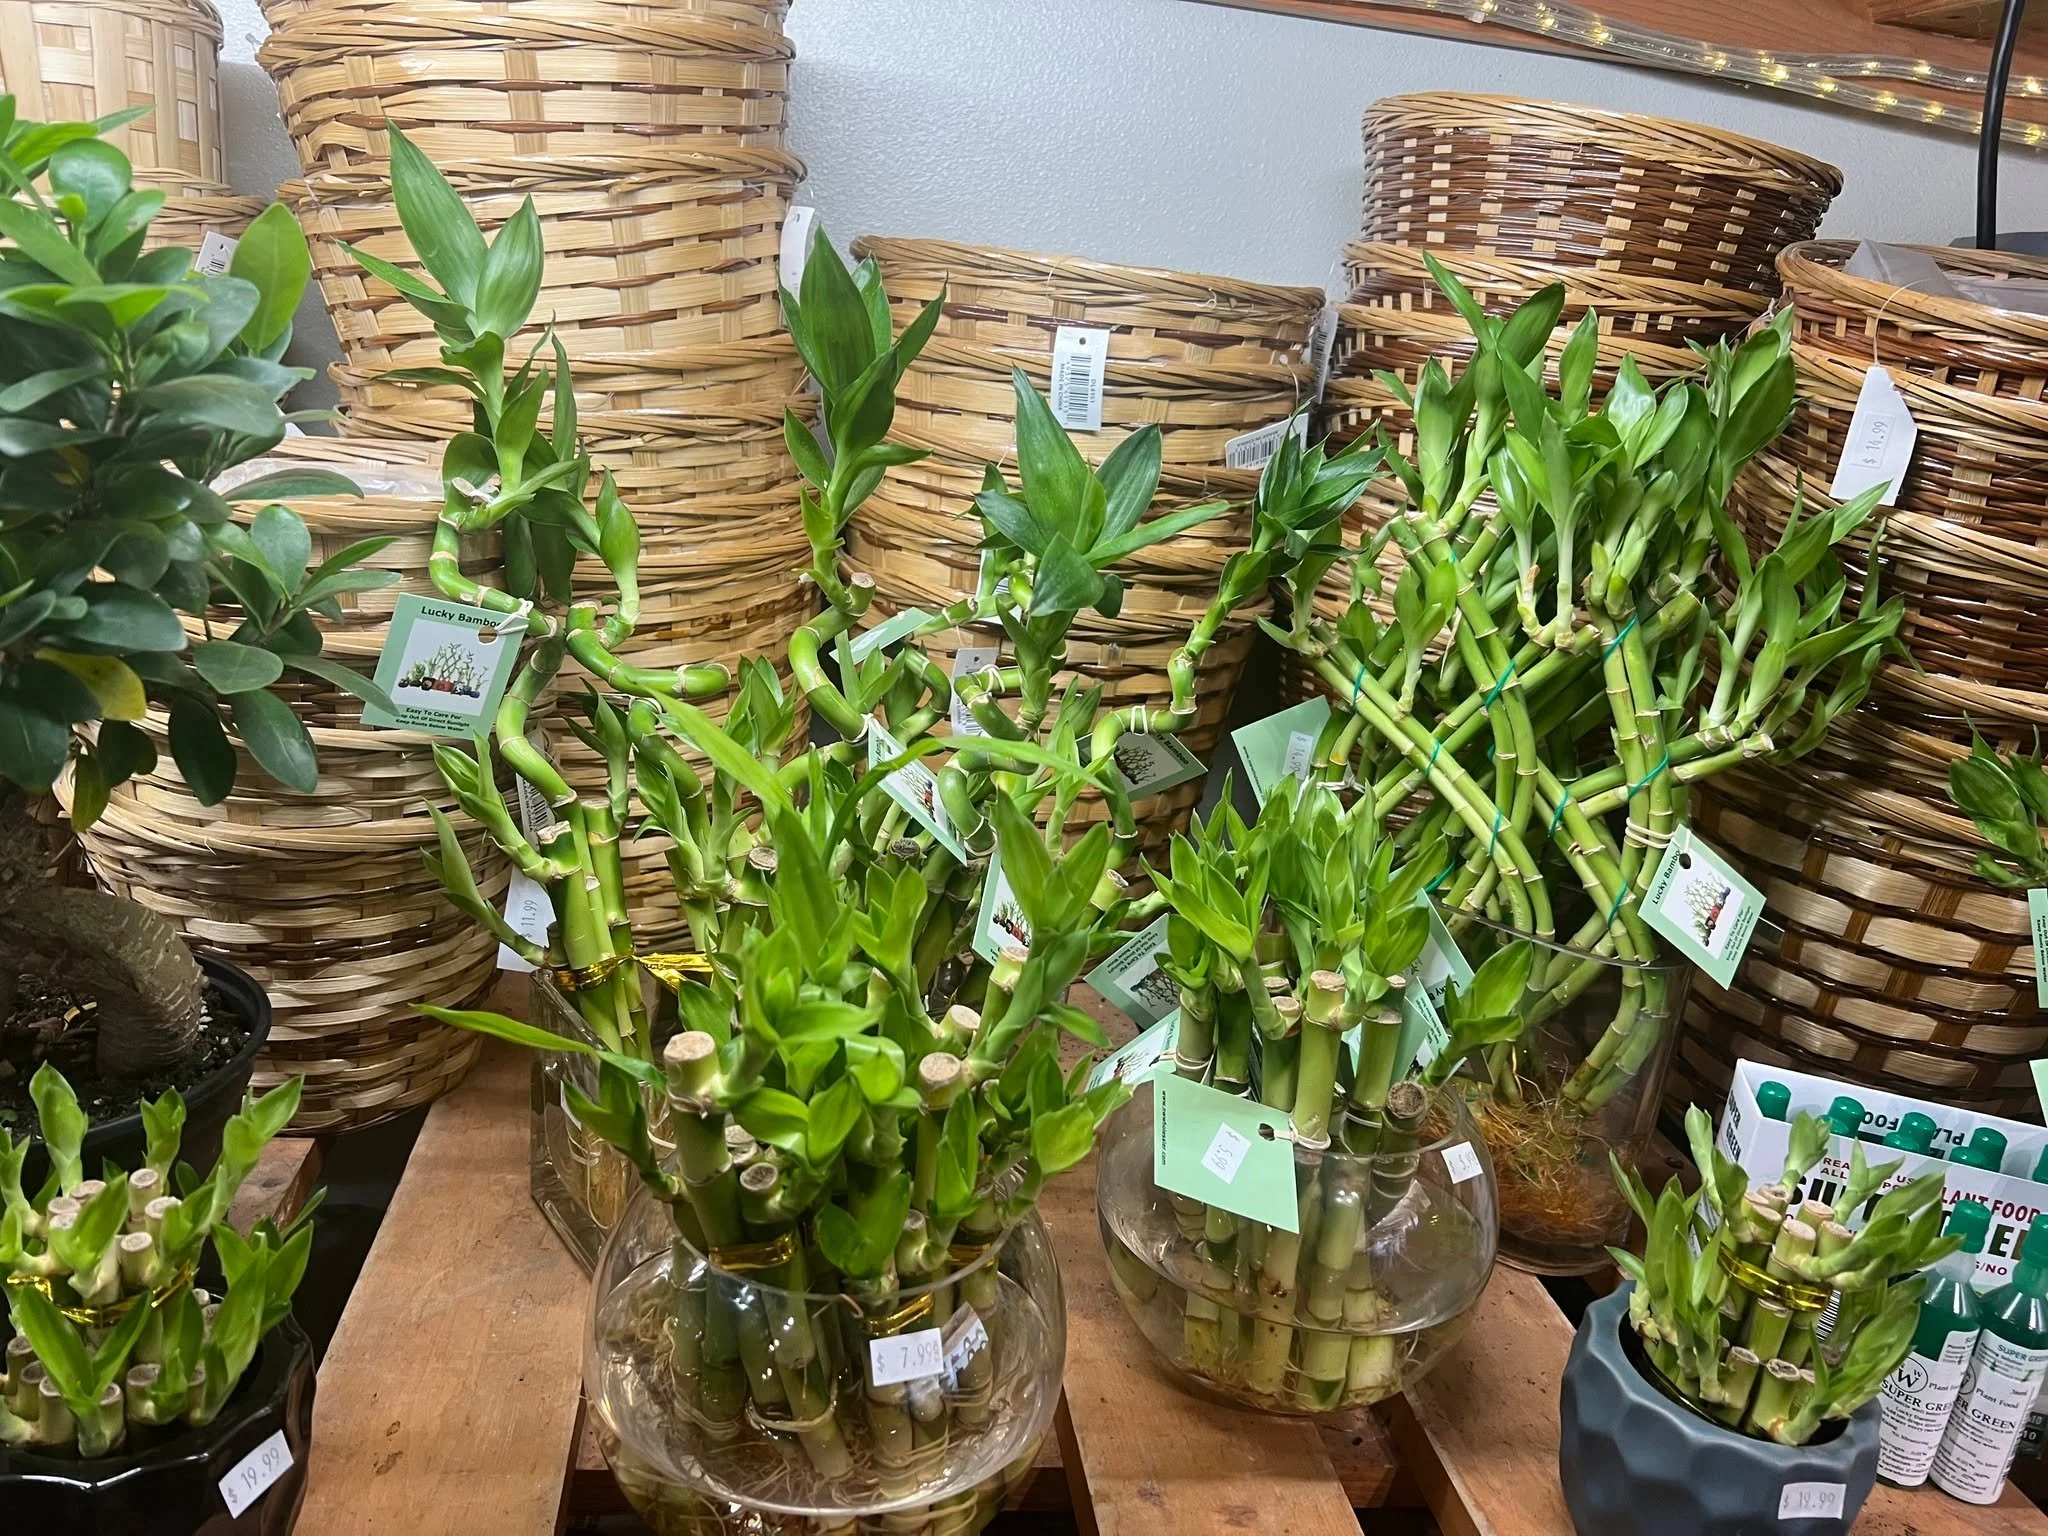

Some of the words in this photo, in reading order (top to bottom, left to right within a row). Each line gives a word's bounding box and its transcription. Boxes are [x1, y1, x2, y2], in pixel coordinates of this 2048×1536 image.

[421, 606, 455, 620] Lucky
[406, 707, 422, 715] Easy
[433, 711, 449, 719] Care
[1163, 740, 1190, 765] Bamboo
[1652, 879, 1669, 905] Lucky
[521, 900, 539, 927] 11.99
[1860, 1111, 1899, 1131] FOO
[1211, 1144, 1233, 1170] 5.99
[1823, 1157, 1850, 1170] REA
[1820, 1167, 1848, 1180] ALL
[877, 1351, 885, 1374] $
[1997, 1344, 2027, 1361] SUPER
[1881, 1378, 1922, 1408] SUPER
[1928, 1382, 1949, 1391] Plant
[1975, 1387, 1997, 1403] Plant
[1999, 1399, 2019, 1409] Food
[1971, 1408, 2015, 1429] GREEN
[2023, 1430, 2037, 1441] 10
[228, 1487, 238, 1504] $
[241, 1447, 280, 1489] 19.99
